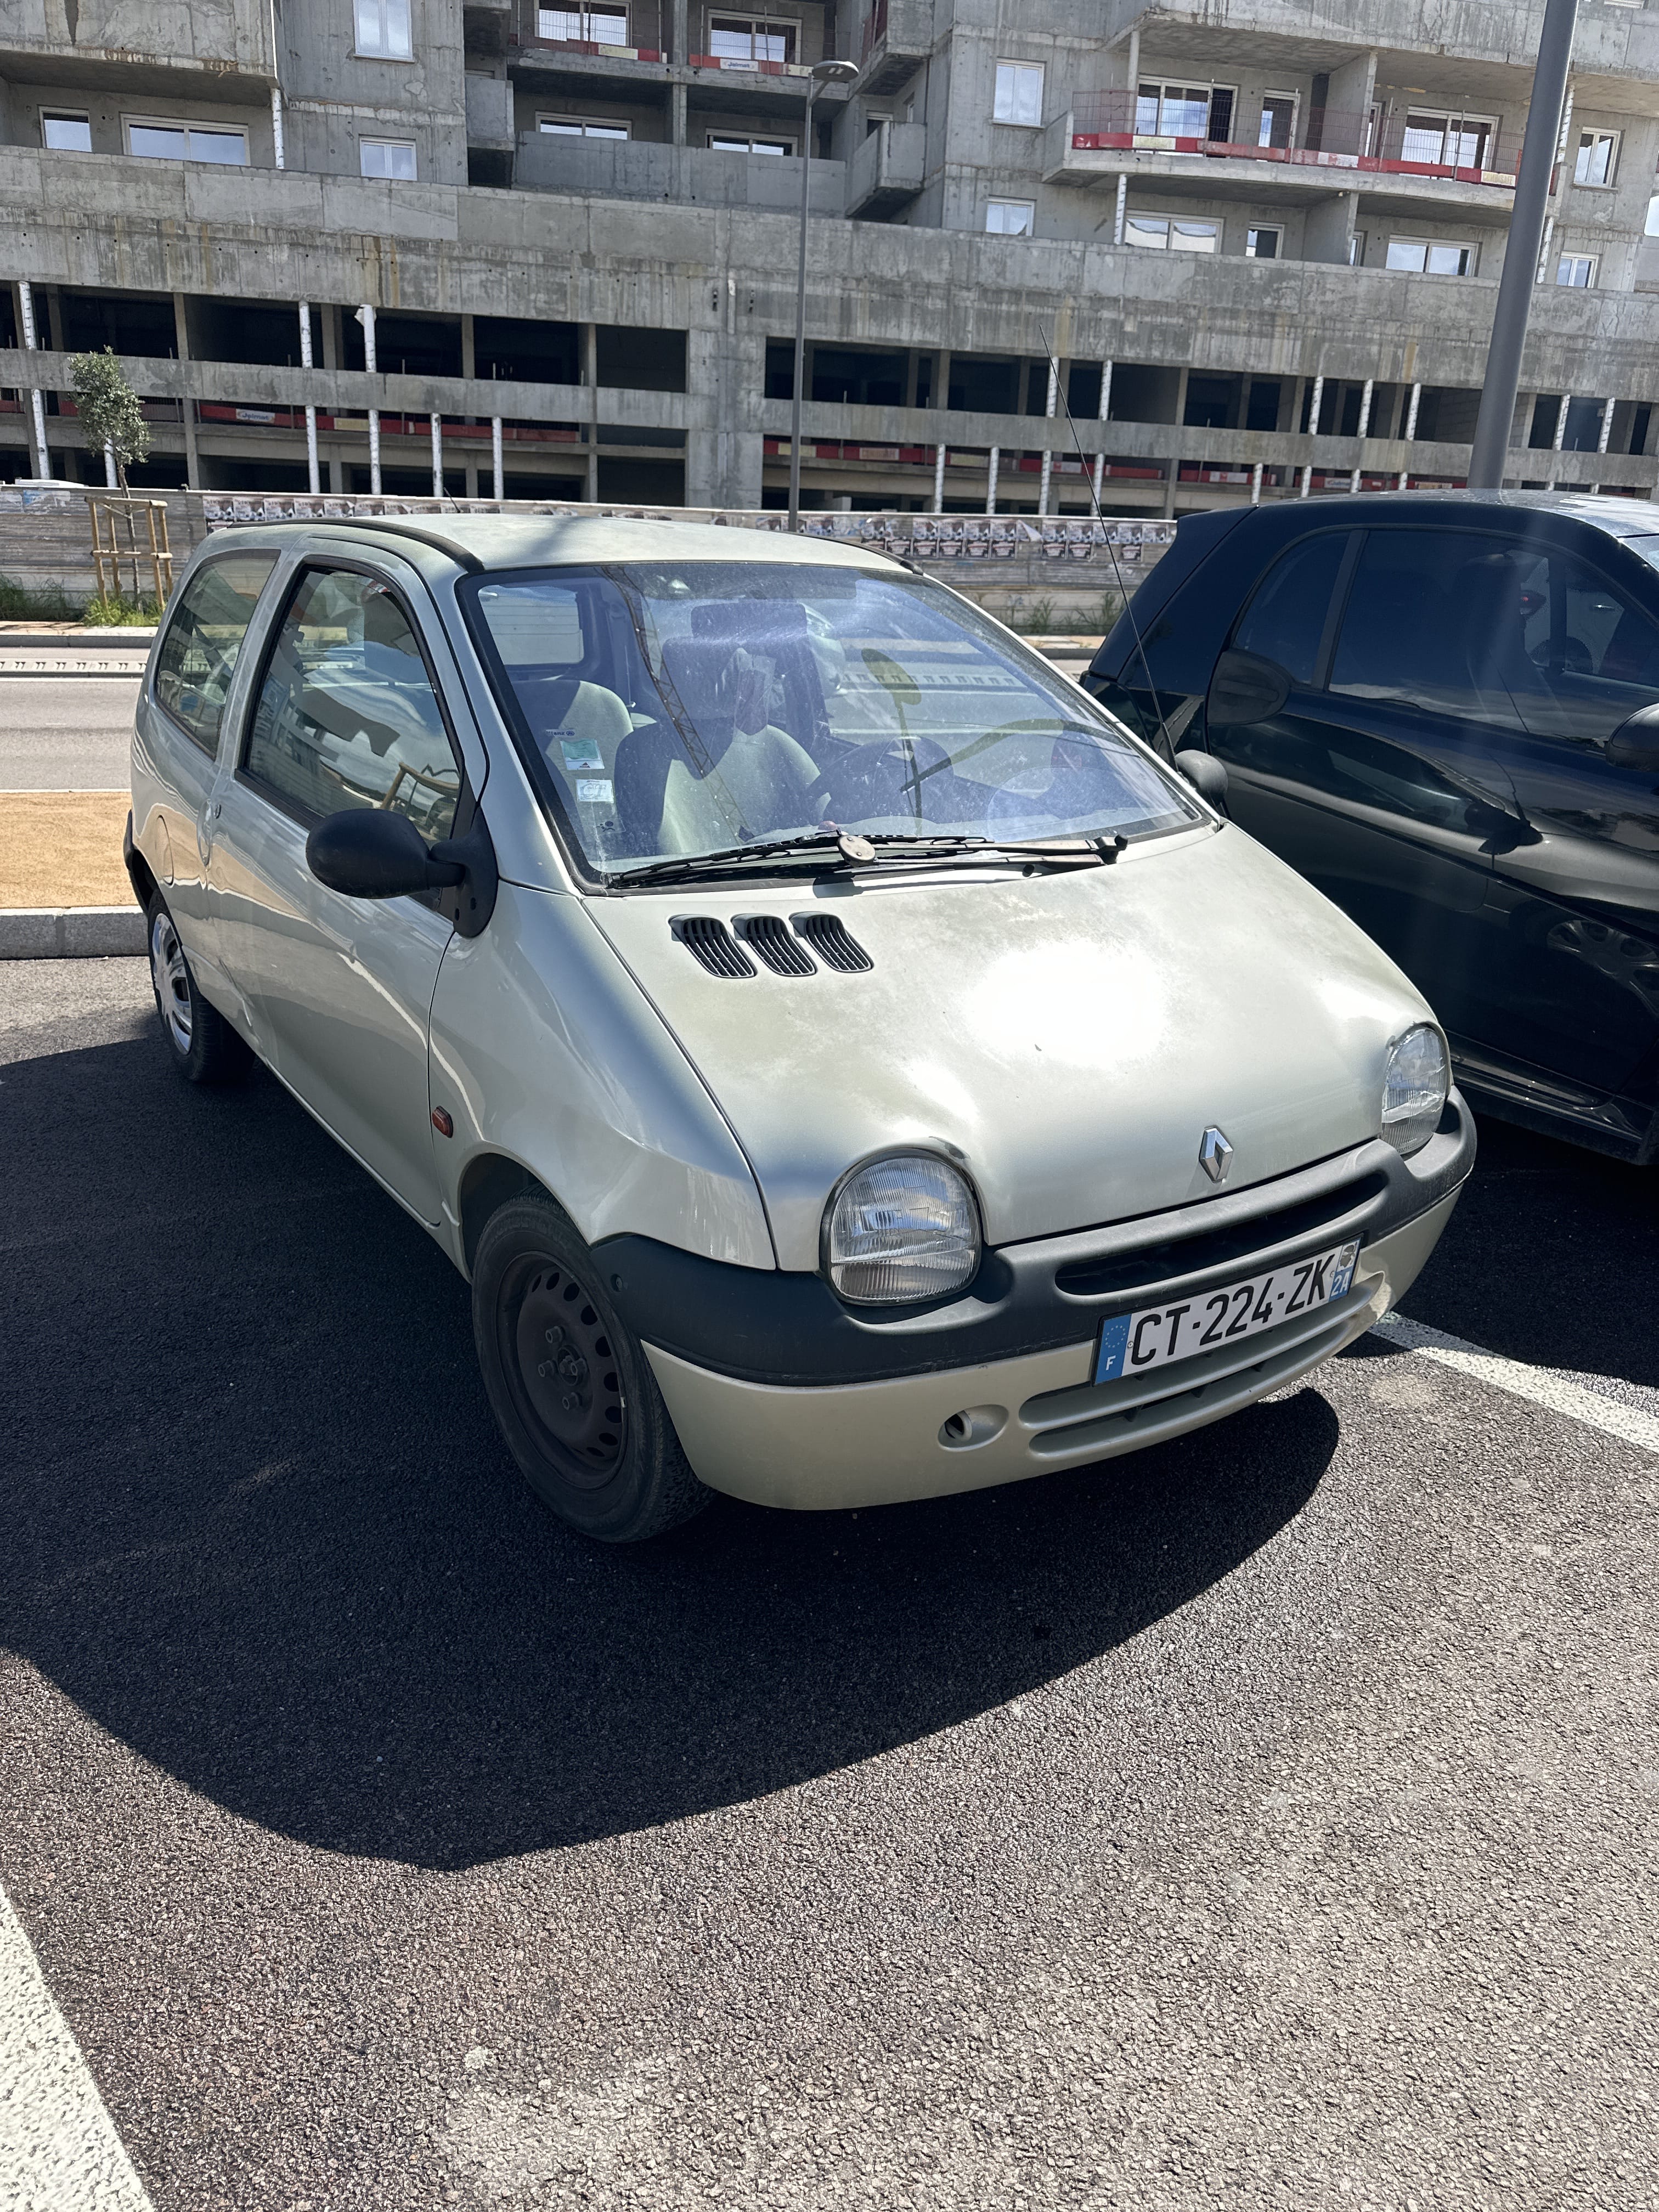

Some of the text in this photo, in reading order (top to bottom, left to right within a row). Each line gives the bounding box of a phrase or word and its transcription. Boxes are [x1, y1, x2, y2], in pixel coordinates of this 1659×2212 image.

[1106, 1254, 1350, 1370] F CT-224-ZK 2A
